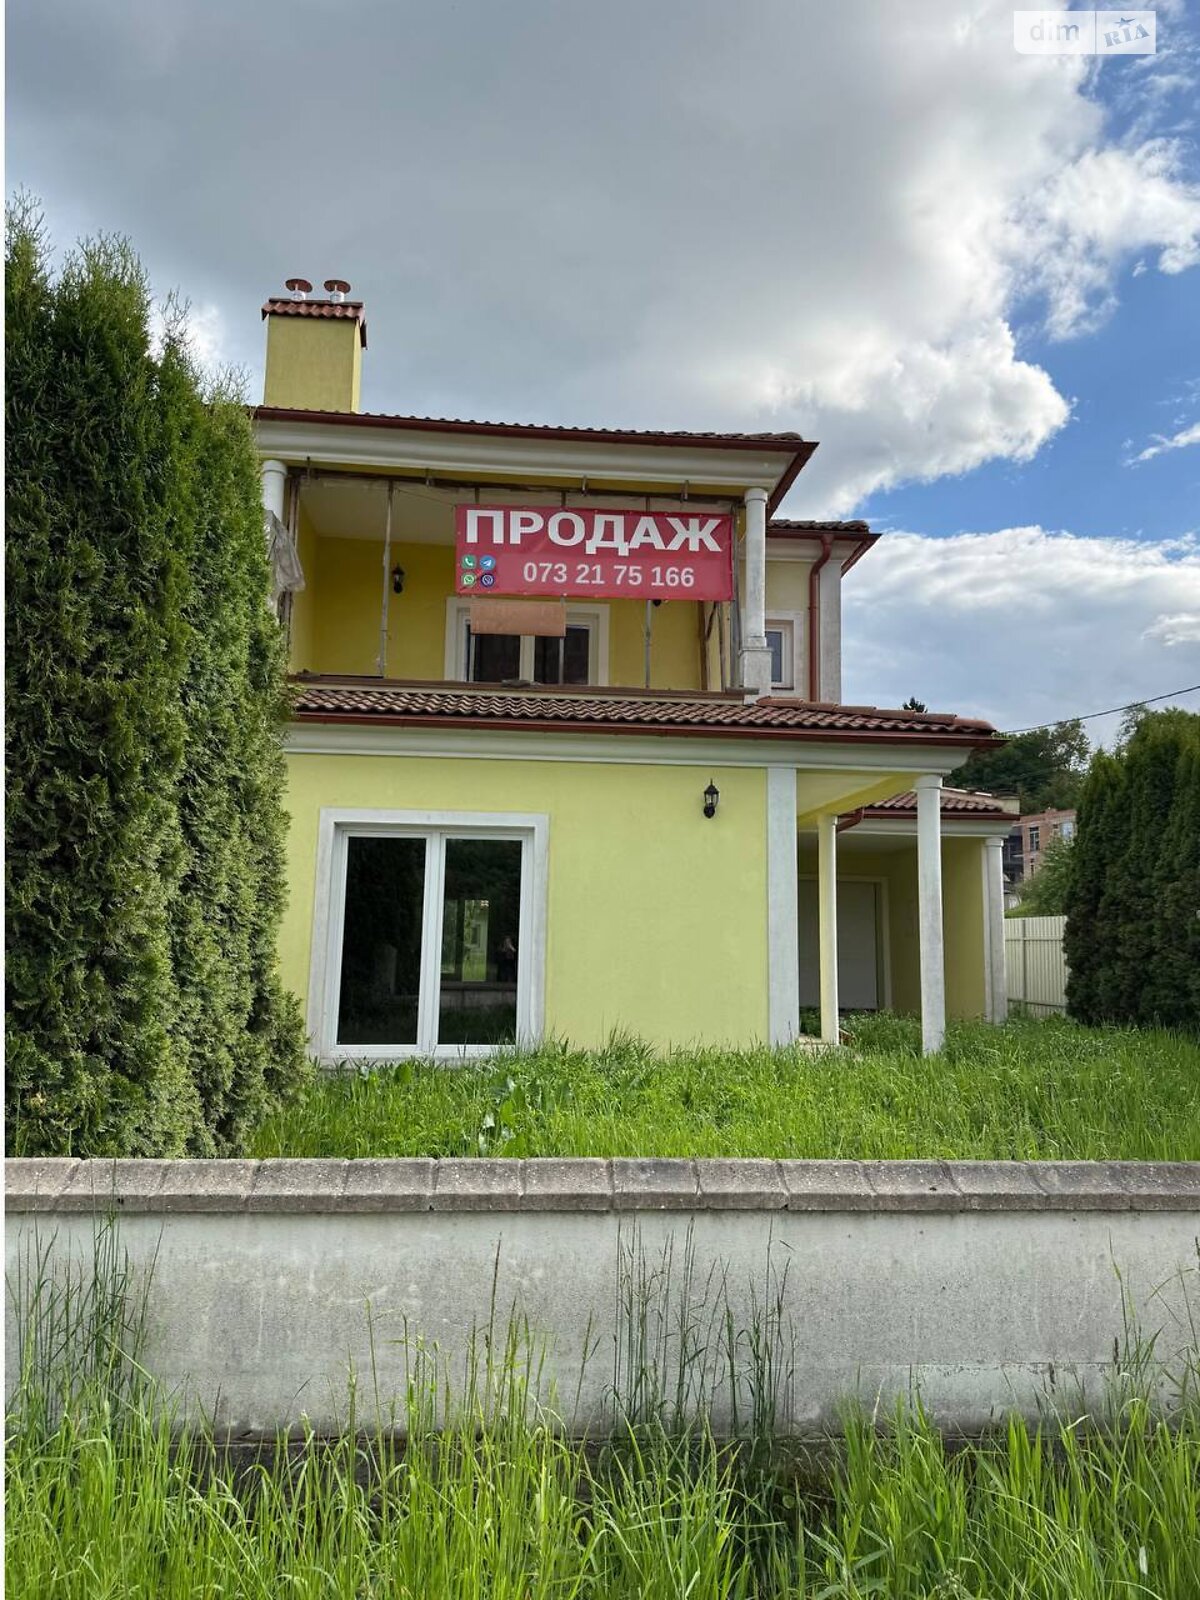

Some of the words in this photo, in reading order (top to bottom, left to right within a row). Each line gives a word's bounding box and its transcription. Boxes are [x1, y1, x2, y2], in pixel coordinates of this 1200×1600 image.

[465, 509, 723, 557] ПРОДАЖ
[522, 562, 568, 584] 073
[574, 564, 606, 585] 21
[613, 565, 643, 586] 75
[650, 566, 695, 588] 166
